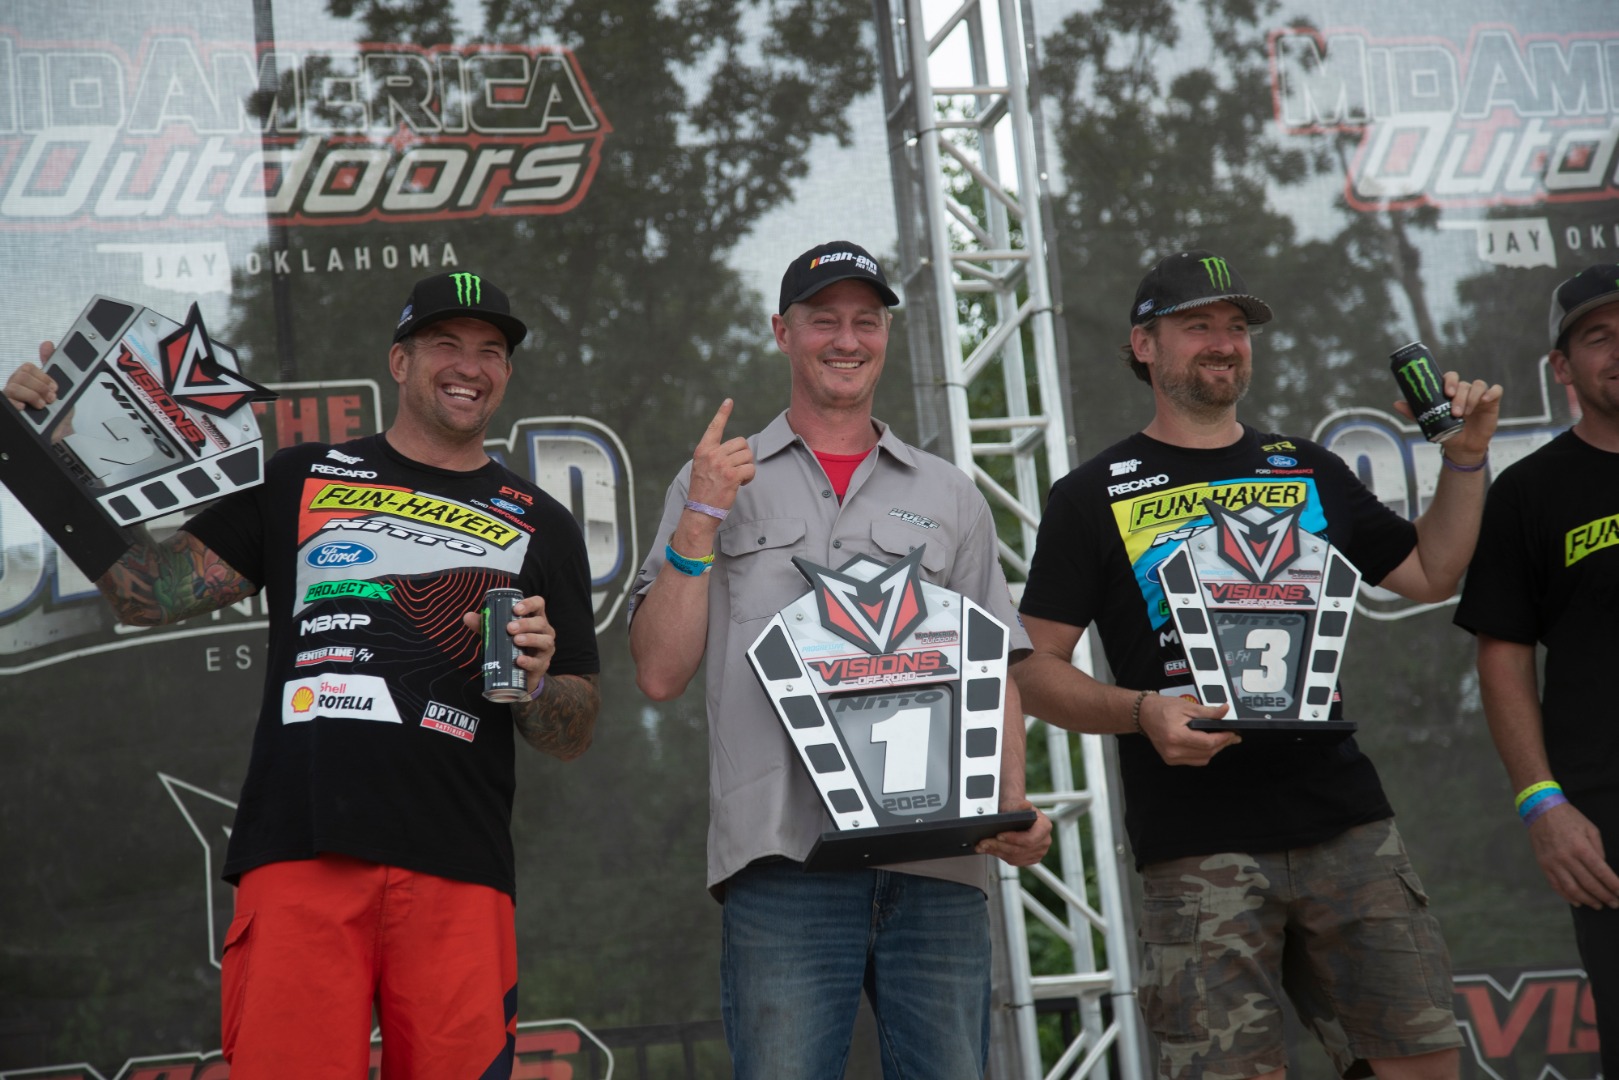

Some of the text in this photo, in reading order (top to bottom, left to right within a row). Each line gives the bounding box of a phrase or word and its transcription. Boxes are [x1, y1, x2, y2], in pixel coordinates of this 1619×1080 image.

[0, 37, 598, 134] IDAMERICA
[1277, 29, 1619, 127] MIDAM
[1356, 112, 1619, 197] Outd
[1488, 226, 1619, 253] JAY OK
[152, 242, 459, 279] JAY OKLAHOMA
[117, 345, 206, 452] VISIONS
[99, 381, 176, 459] NITTO
[251, 395, 361, 449] HE
[310, 463, 378, 479] RECARO
[1107, 473, 1169, 497] RECARO
[318, 486, 511, 541] FUN-HAVER
[488, 505, 537, 533] PERFORMANCE
[1136, 485, 1300, 526] FUN-HAVER
[321, 518, 488, 556] NITTO
[317, 545, 362, 564] Ford
[306, 582, 367, 597] PROJECT
[1210, 583, 1307, 601] VISIONS
[300, 613, 371, 636] MBRP
[1217, 614, 1301, 627] NITTO
[206, 644, 269, 671] ES
[296, 648, 328, 662] CENTER
[328, 647, 353, 658] LINE
[811, 650, 944, 682] VISIONS
[1242, 628, 1291, 693] 3
[320, 682, 346, 694] Shell
[857, 671, 916, 686] OFF-ROAD
[318, 694, 374, 711] ROTELLA
[835, 690, 944, 714] NITTO
[428, 703, 477, 731] OPTIMA
[870, 707, 931, 795] 1
[881, 793, 942, 812] 2022
